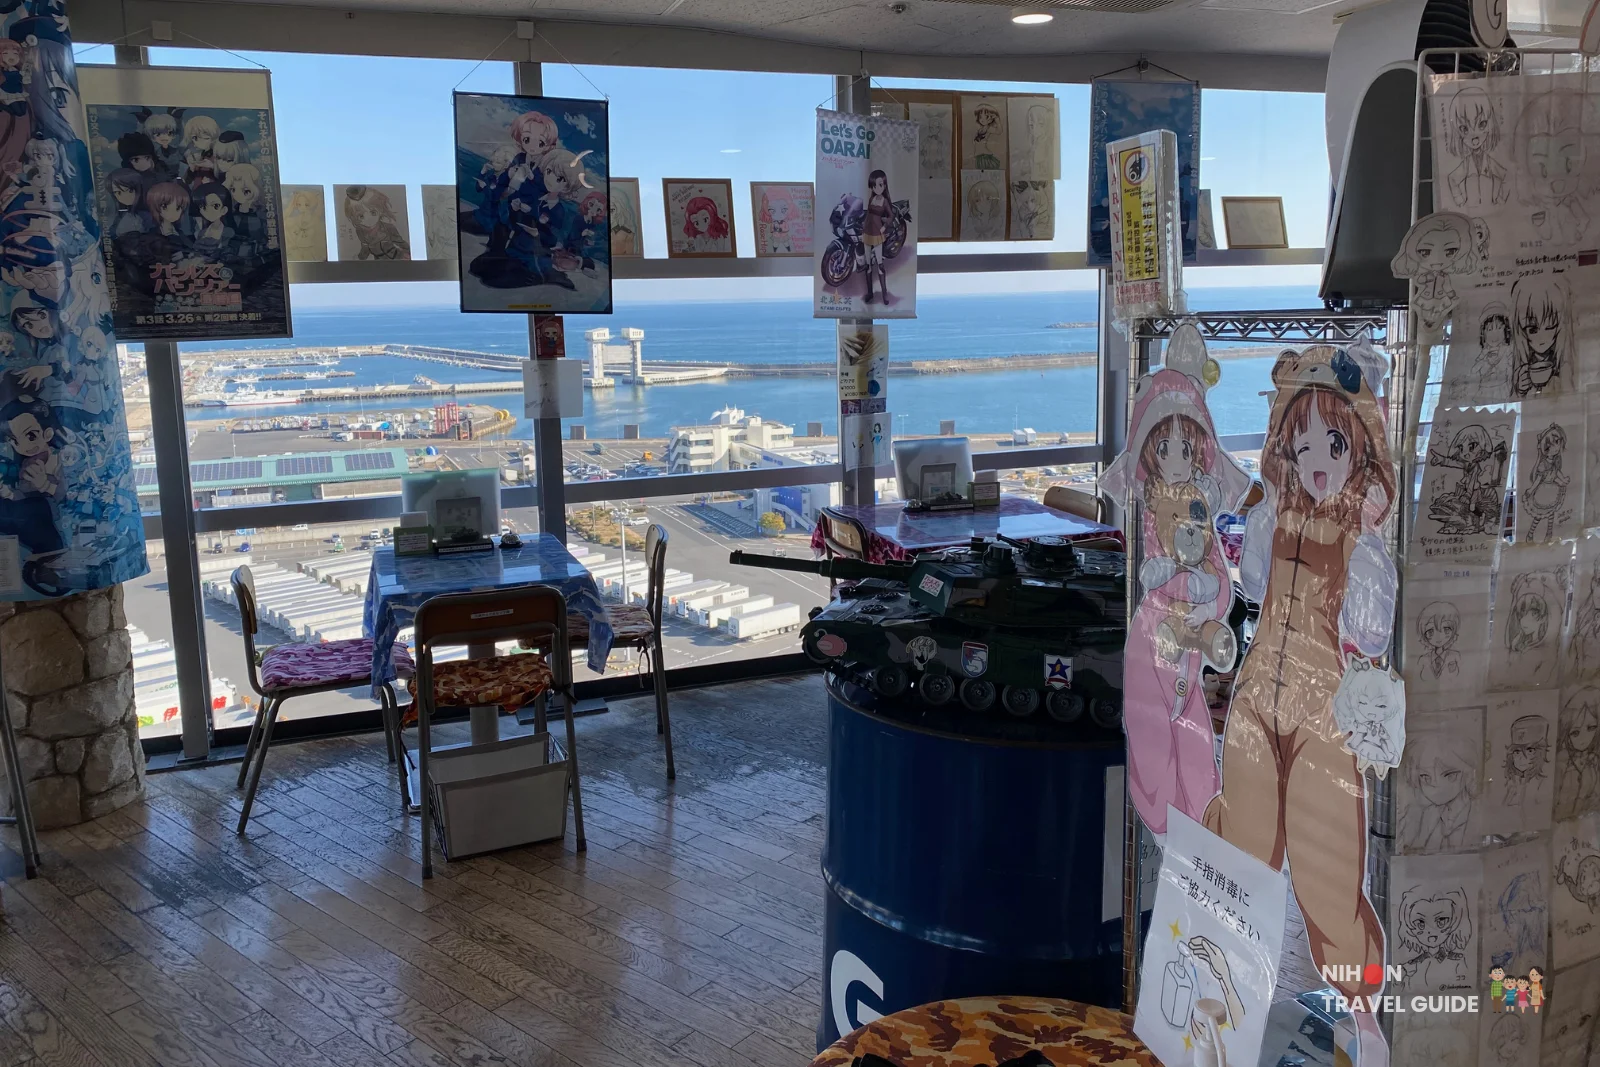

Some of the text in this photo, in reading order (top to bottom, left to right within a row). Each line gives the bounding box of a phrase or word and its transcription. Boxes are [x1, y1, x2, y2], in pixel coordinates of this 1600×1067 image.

[820, 137, 871, 159] OARAI
[821, 120, 876, 142] Let's Go
[1109, 153, 1123, 283] WARNING
[165, 313, 194, 324] 3.26
[1191, 855, 1251, 908] 手指消毒に
[1177, 873, 1263, 941] ご協力ください
